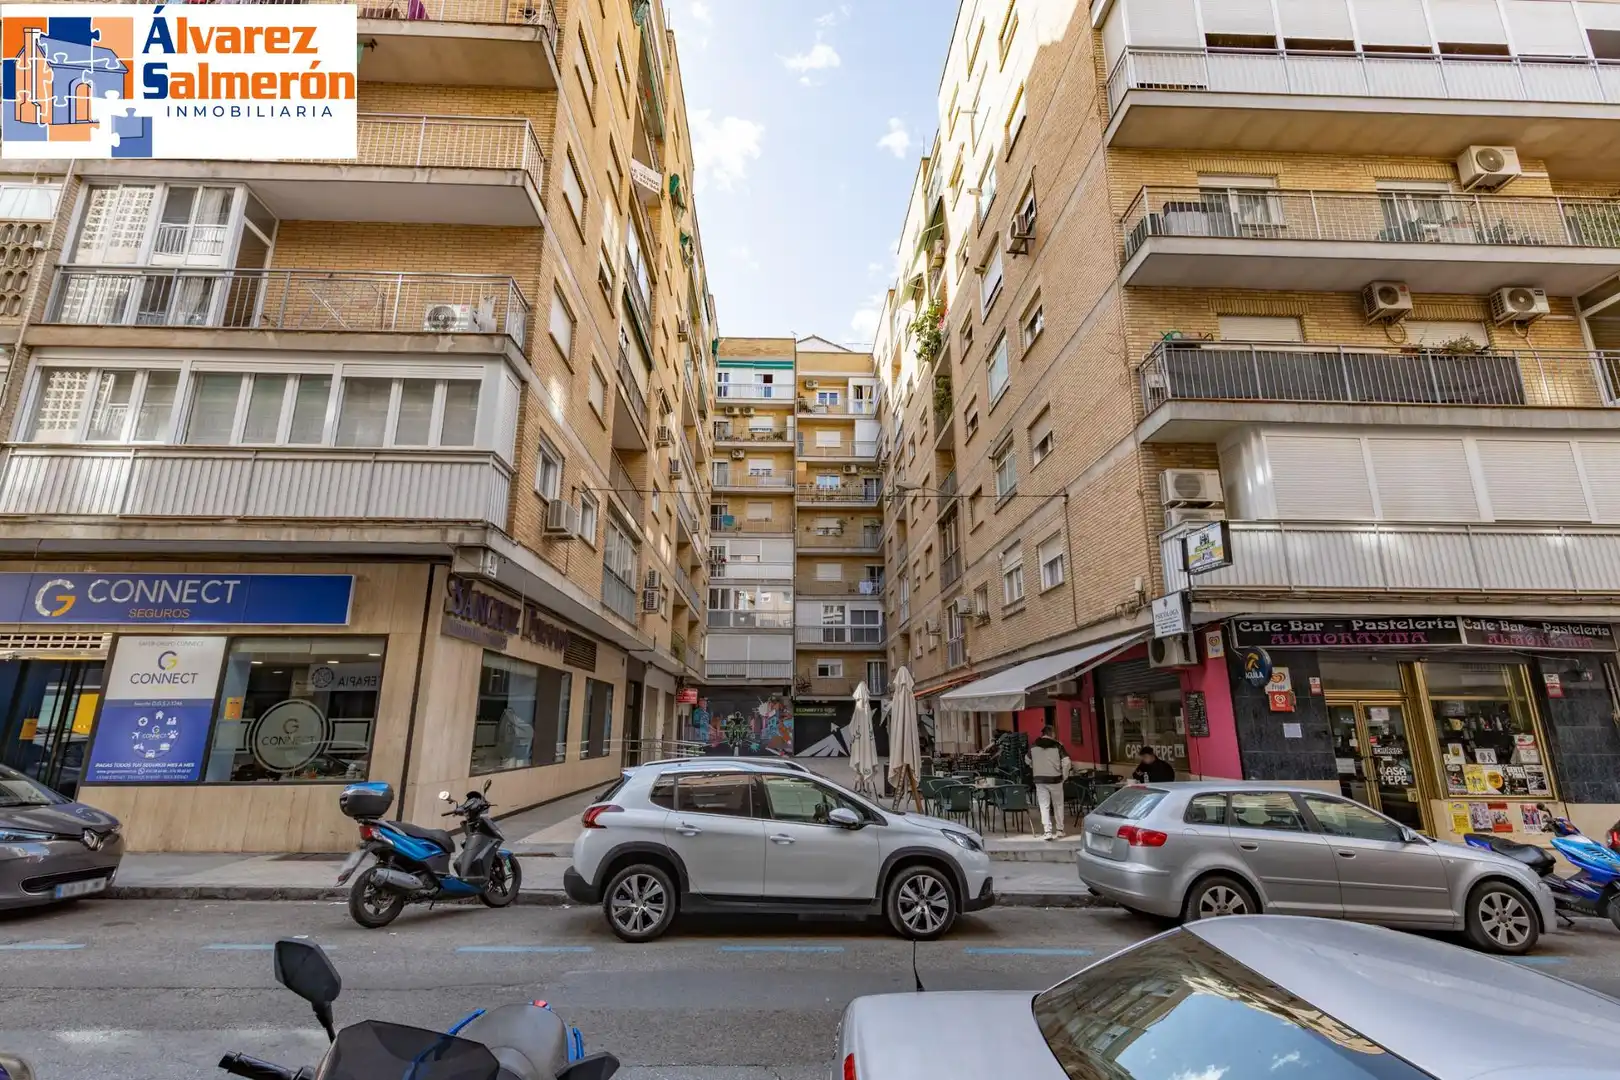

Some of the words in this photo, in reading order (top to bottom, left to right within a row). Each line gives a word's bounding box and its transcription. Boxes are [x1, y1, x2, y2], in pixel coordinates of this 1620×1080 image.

[87, 579, 241, 604] CONNECT
[128, 608, 190, 618] SEGUROS
[130, 673, 198, 685] CONNECT
